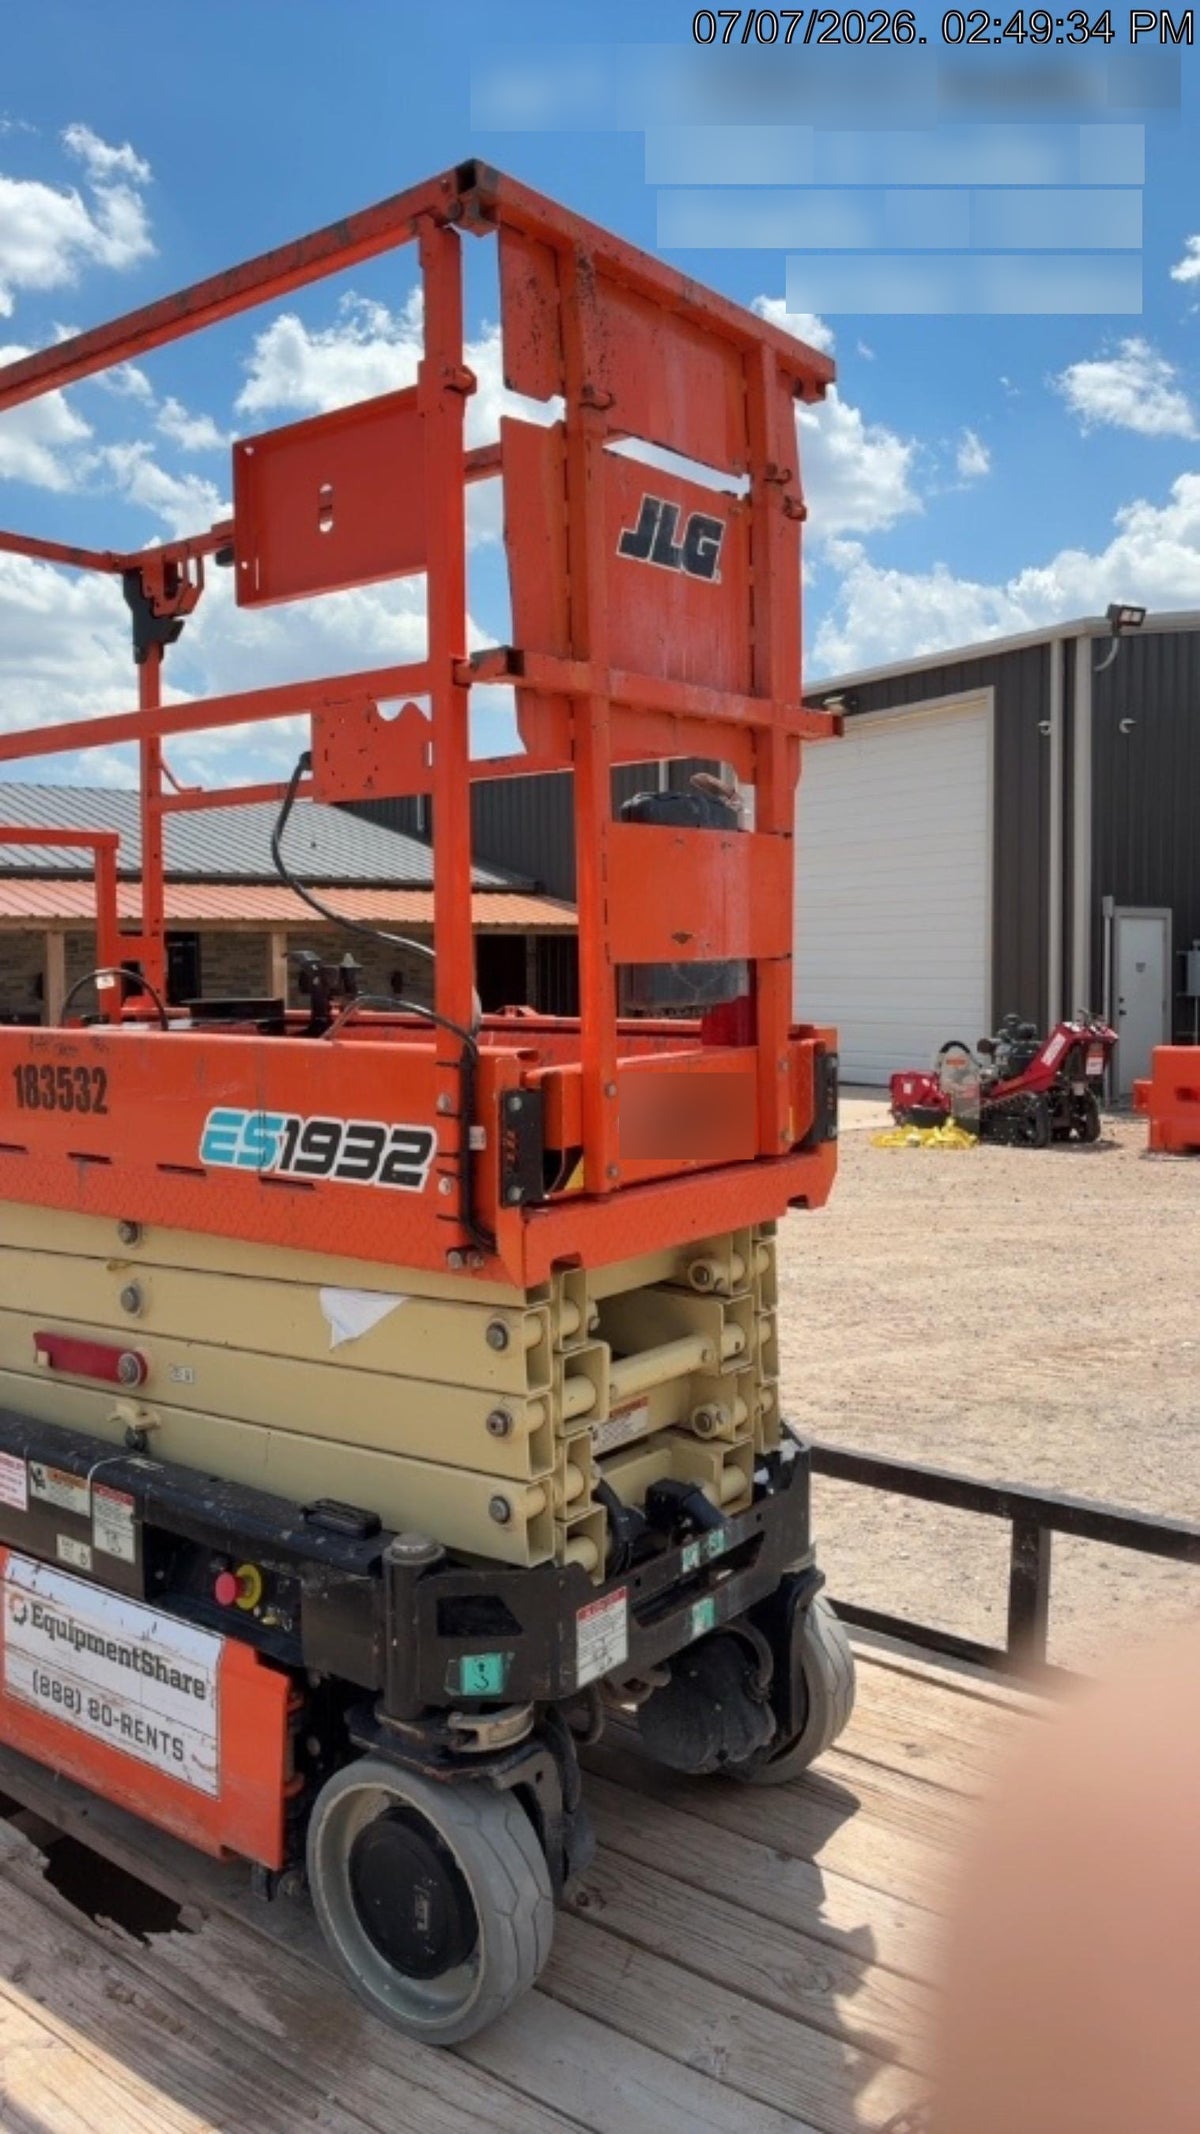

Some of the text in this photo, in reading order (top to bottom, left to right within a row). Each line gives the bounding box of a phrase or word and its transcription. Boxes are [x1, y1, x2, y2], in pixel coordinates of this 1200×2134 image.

[616, 492, 726, 582] JLG
[13, 1064, 108, 1114] 183532
[200, 1107, 437, 1193] ES1932
[31, 1604, 207, 1700] EquipmentShare
[32, 1668, 184, 1762] (888) 80-RENTS
